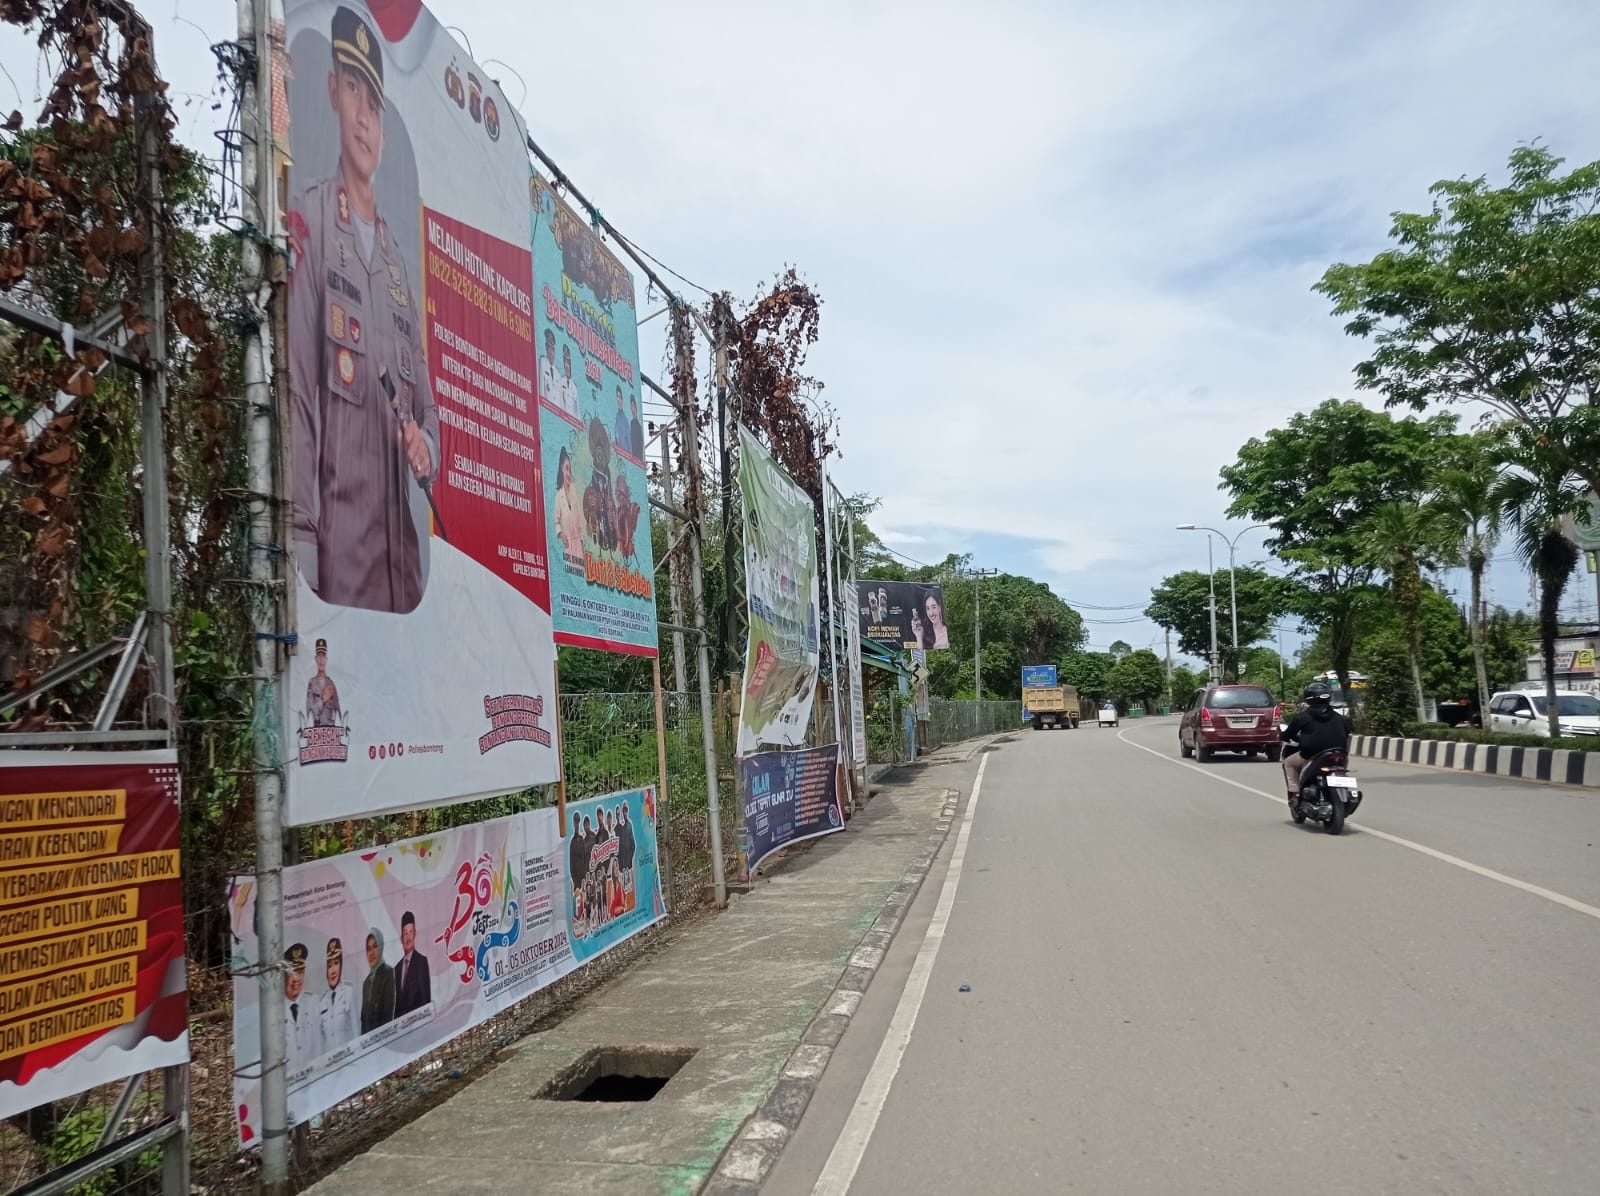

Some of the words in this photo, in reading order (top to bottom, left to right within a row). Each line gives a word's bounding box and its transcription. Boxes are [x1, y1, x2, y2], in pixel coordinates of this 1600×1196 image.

[428, 217, 463, 266] MELALUI
[465, 247, 496, 291] HOTLINE
[496, 272, 531, 317] KAPOLRES
[429, 251, 451, 286] 0822
[452, 267, 473, 303] 5252
[37, 795, 116, 820] MENGINDARI
[36, 830, 108, 858] KEBENCIAN
[72, 859, 139, 888] INFORMASI
[141, 854, 174, 877] HOAX
[43, 899, 93, 929] POLITIK
[96, 894, 127, 919] UANG
[88, 926, 138, 956] PILKADA
[495, 960, 504, 976] 01
[510, 953, 519, 970] 05
[520, 938, 554, 965] OKTOBER
[554, 930, 568, 949] 2024
[34, 971, 86, 1005] DENGAN
[90, 962, 133, 990] JUJUR,
[29, 998, 124, 1045] BERINTEGRITAS
